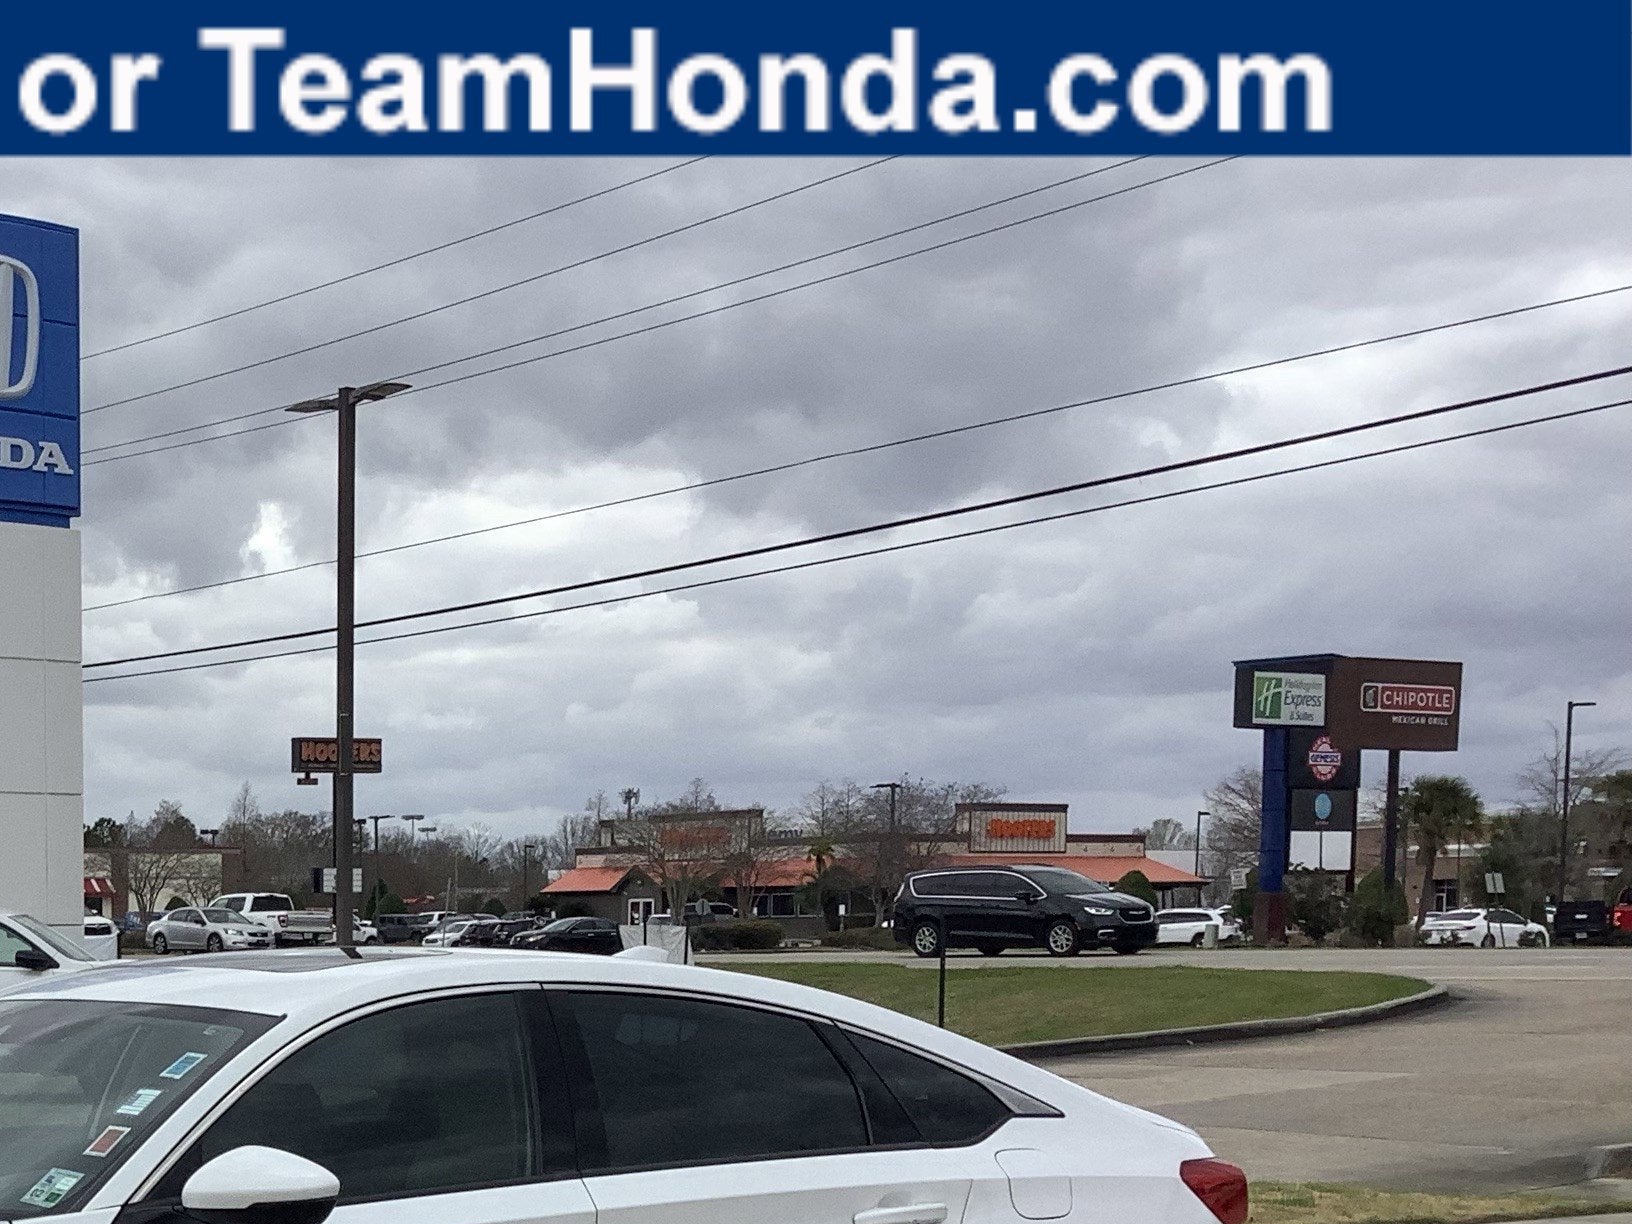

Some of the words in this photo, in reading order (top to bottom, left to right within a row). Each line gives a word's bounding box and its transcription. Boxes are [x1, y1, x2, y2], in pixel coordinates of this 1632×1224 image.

[1284, 690, 1323, 709] Express
[1383, 691, 1451, 708] CHIPOTLE
[301, 741, 381, 762] HOOERS
